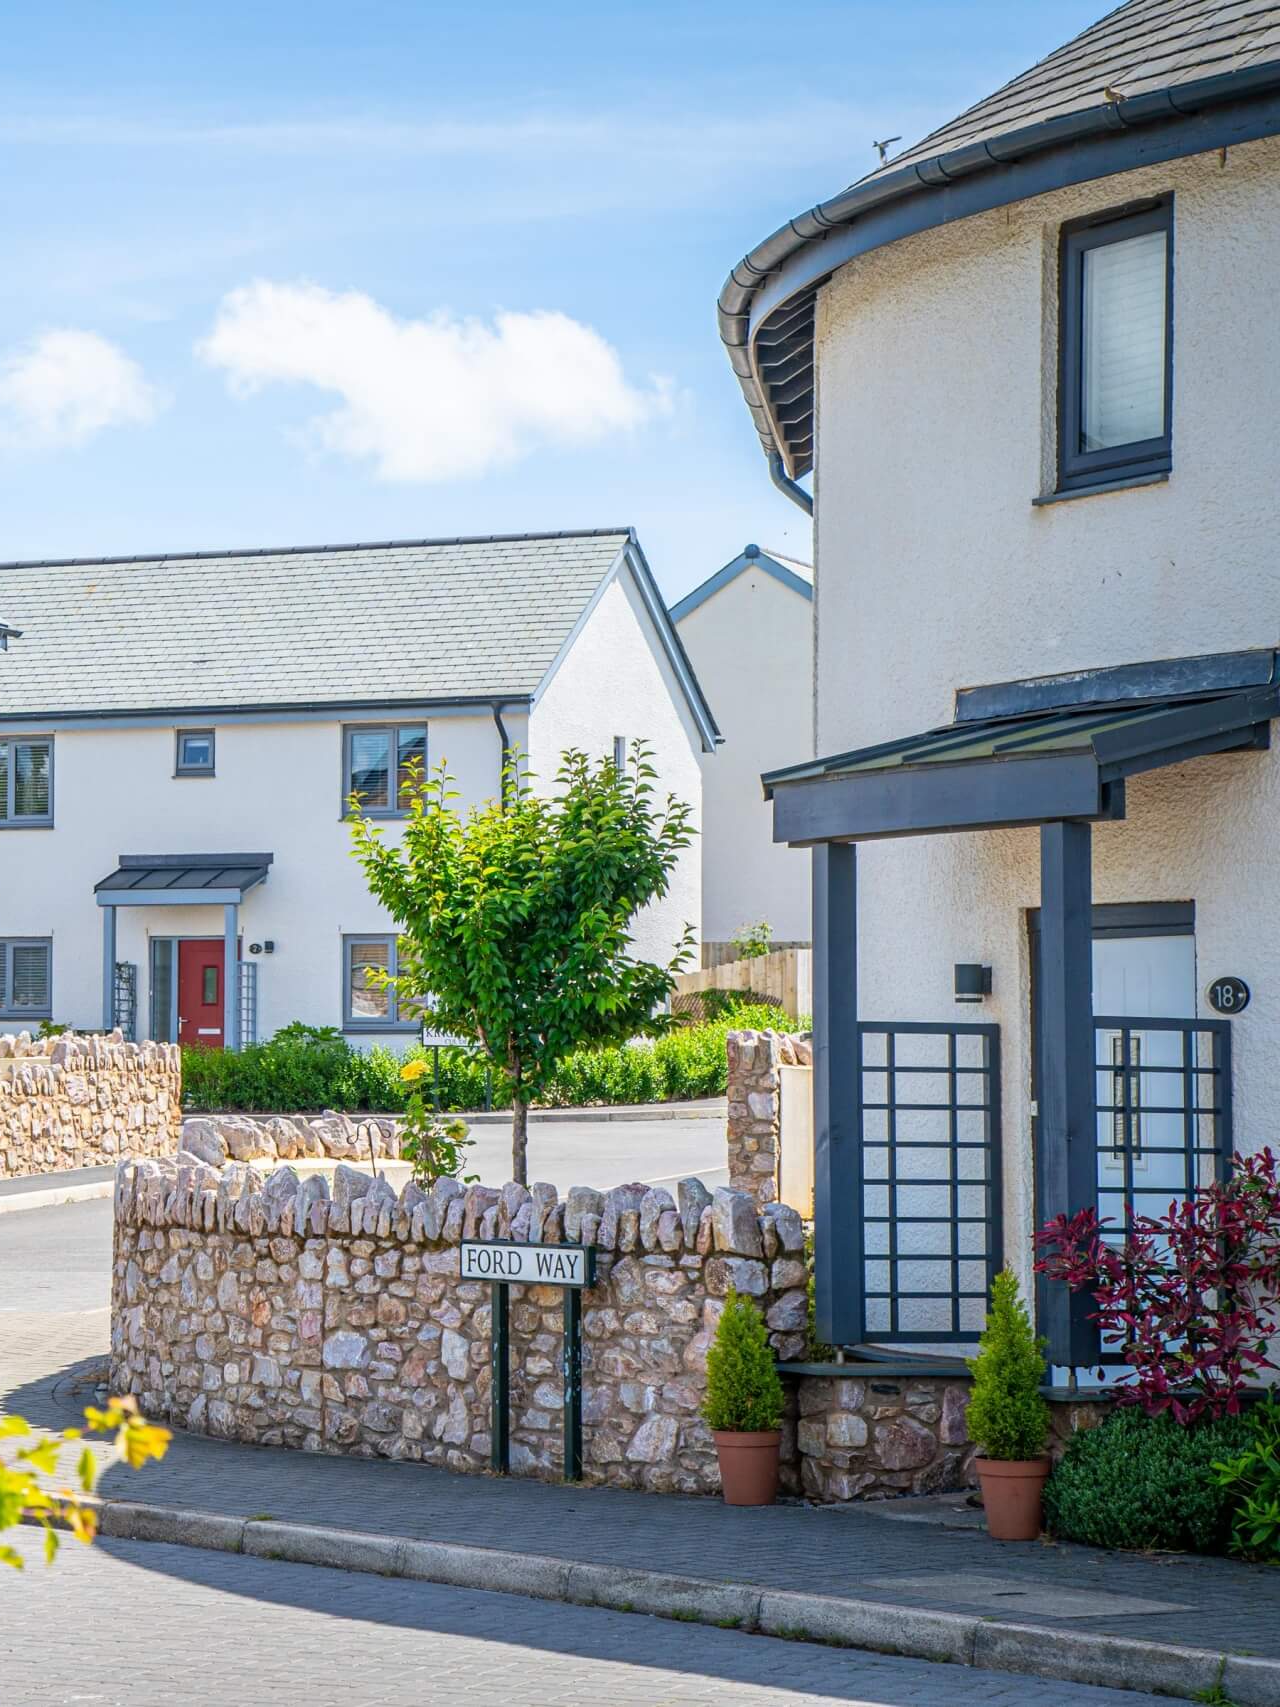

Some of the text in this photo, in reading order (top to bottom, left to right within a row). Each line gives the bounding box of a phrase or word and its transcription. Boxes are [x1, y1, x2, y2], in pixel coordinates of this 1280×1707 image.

[1215, 985, 1234, 1007] 18
[467, 1248, 579, 1279] FORD WAY
